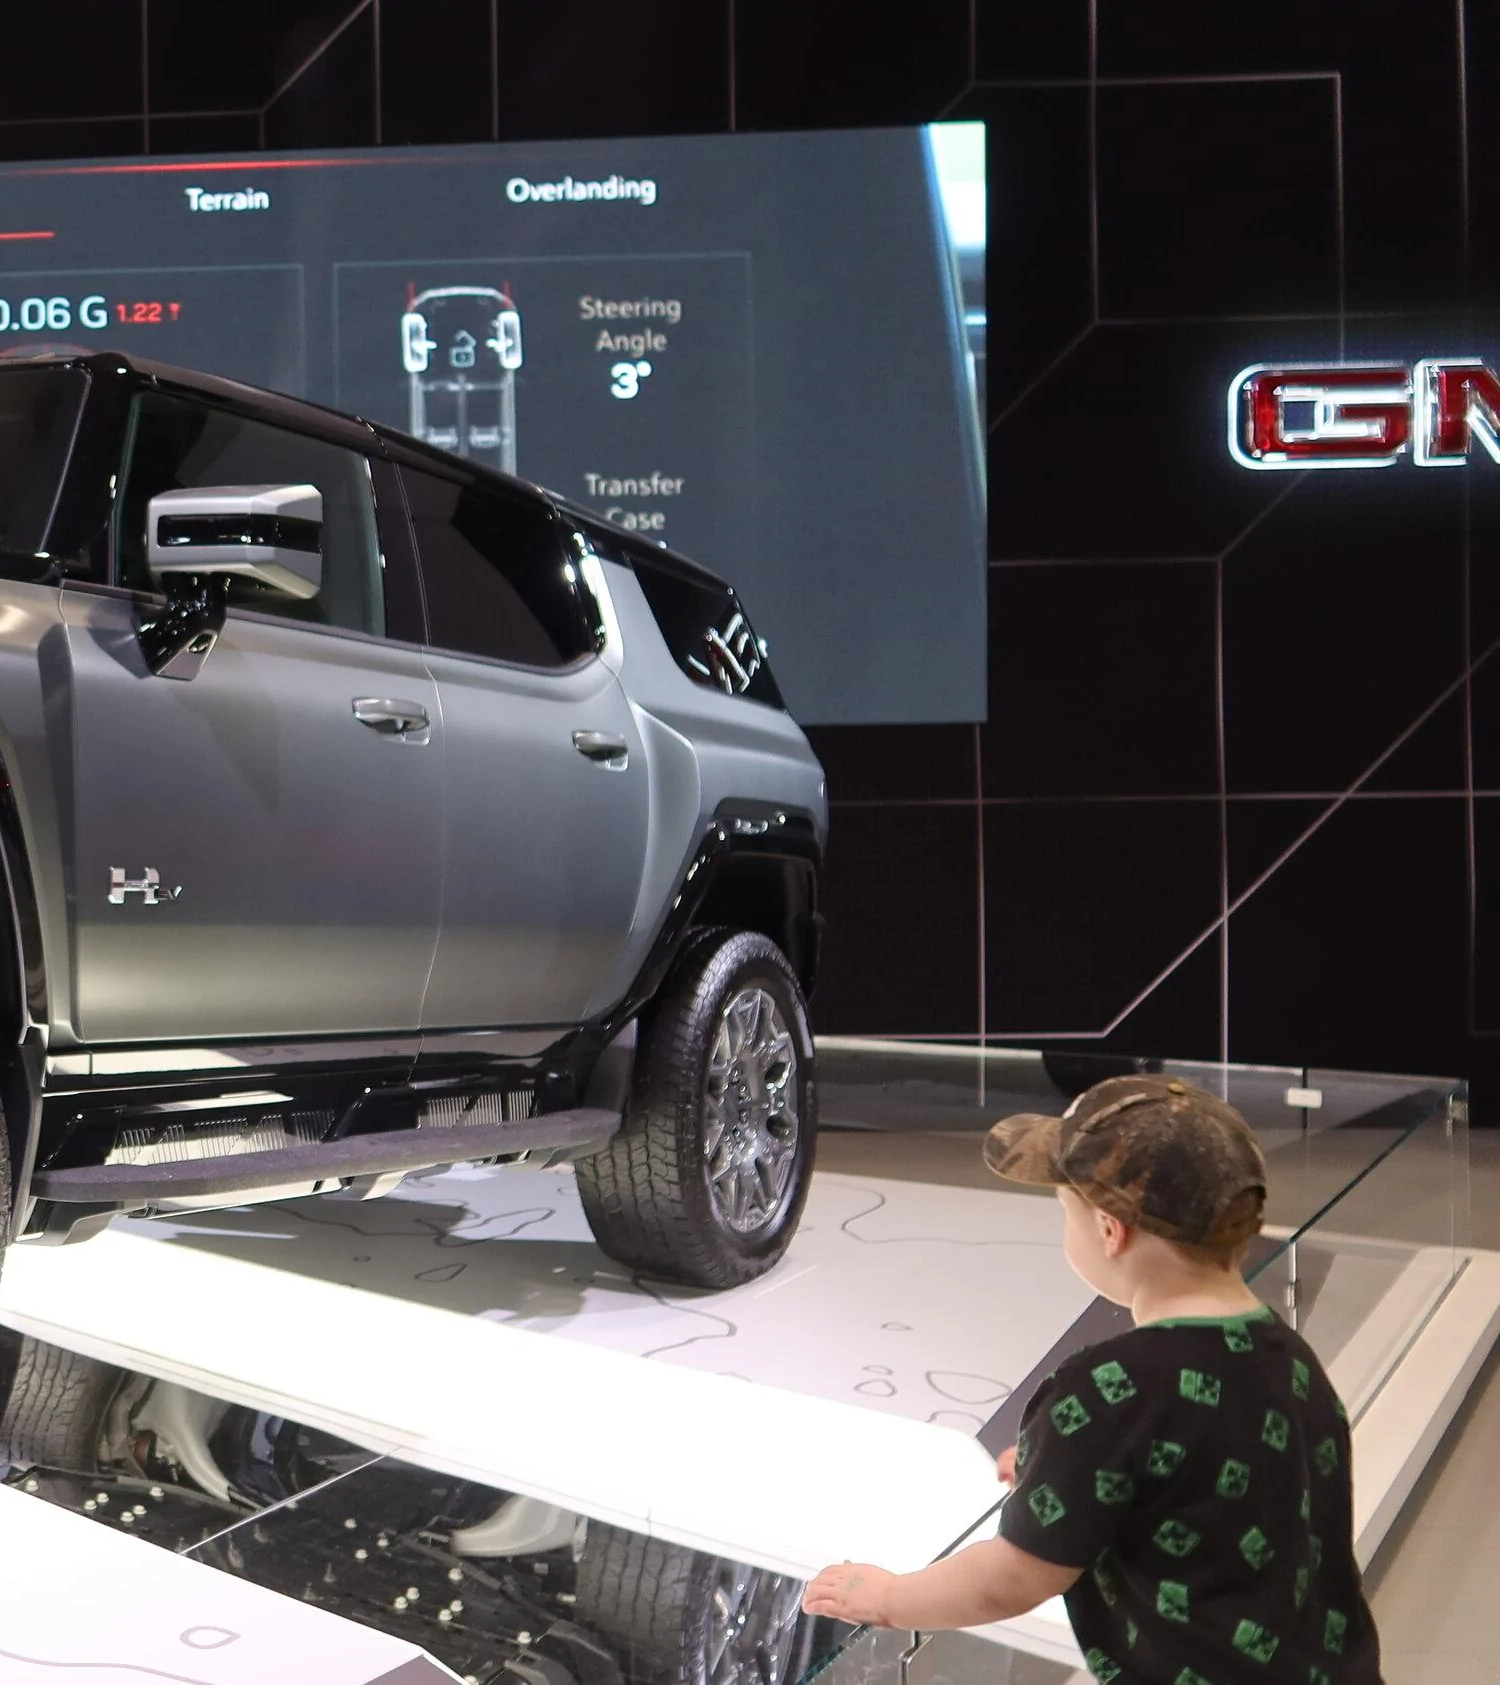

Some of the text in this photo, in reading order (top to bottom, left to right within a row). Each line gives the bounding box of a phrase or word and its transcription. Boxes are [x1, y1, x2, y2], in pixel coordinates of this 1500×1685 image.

[184, 186, 270, 212] Terrain
[506, 174, 657, 205] Overlanding
[79, 295, 108, 329] G
[116, 302, 163, 323] 1.22
[579, 295, 682, 324] Steering
[595, 327, 668, 358] Angle
[584, 471, 685, 496] Transfer
